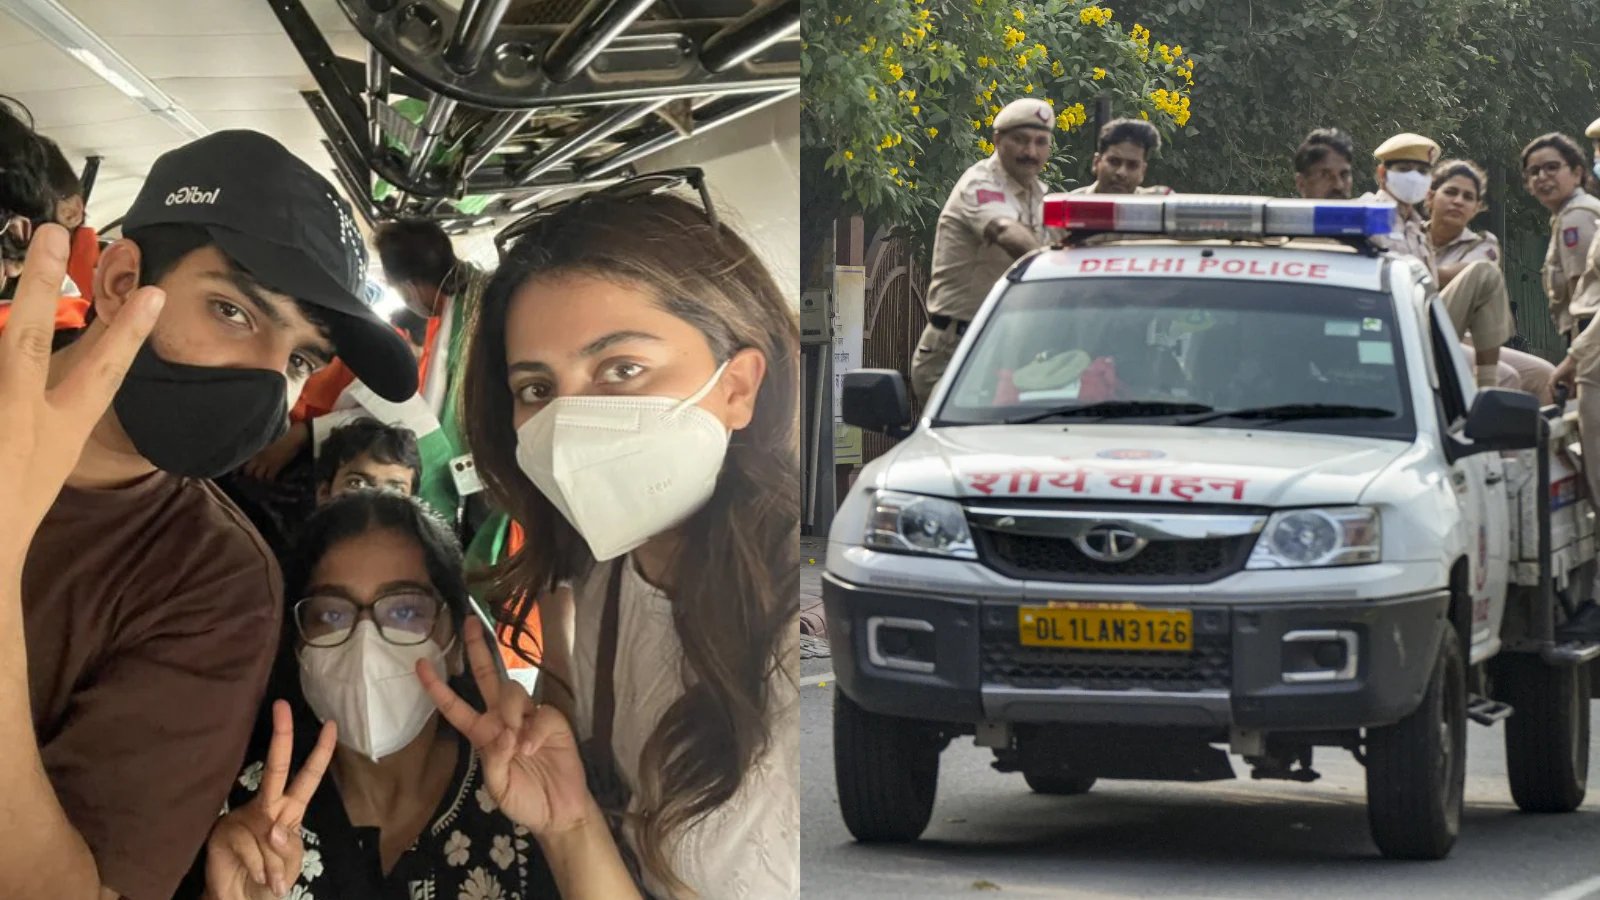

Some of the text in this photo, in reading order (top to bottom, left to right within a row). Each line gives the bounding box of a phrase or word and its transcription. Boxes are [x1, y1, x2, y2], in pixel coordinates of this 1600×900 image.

[1079, 257, 1329, 279] DELHI POLICE
[1107, 471, 1250, 501] वाहन
[1036, 617, 1188, 643] DL1LAN3126
